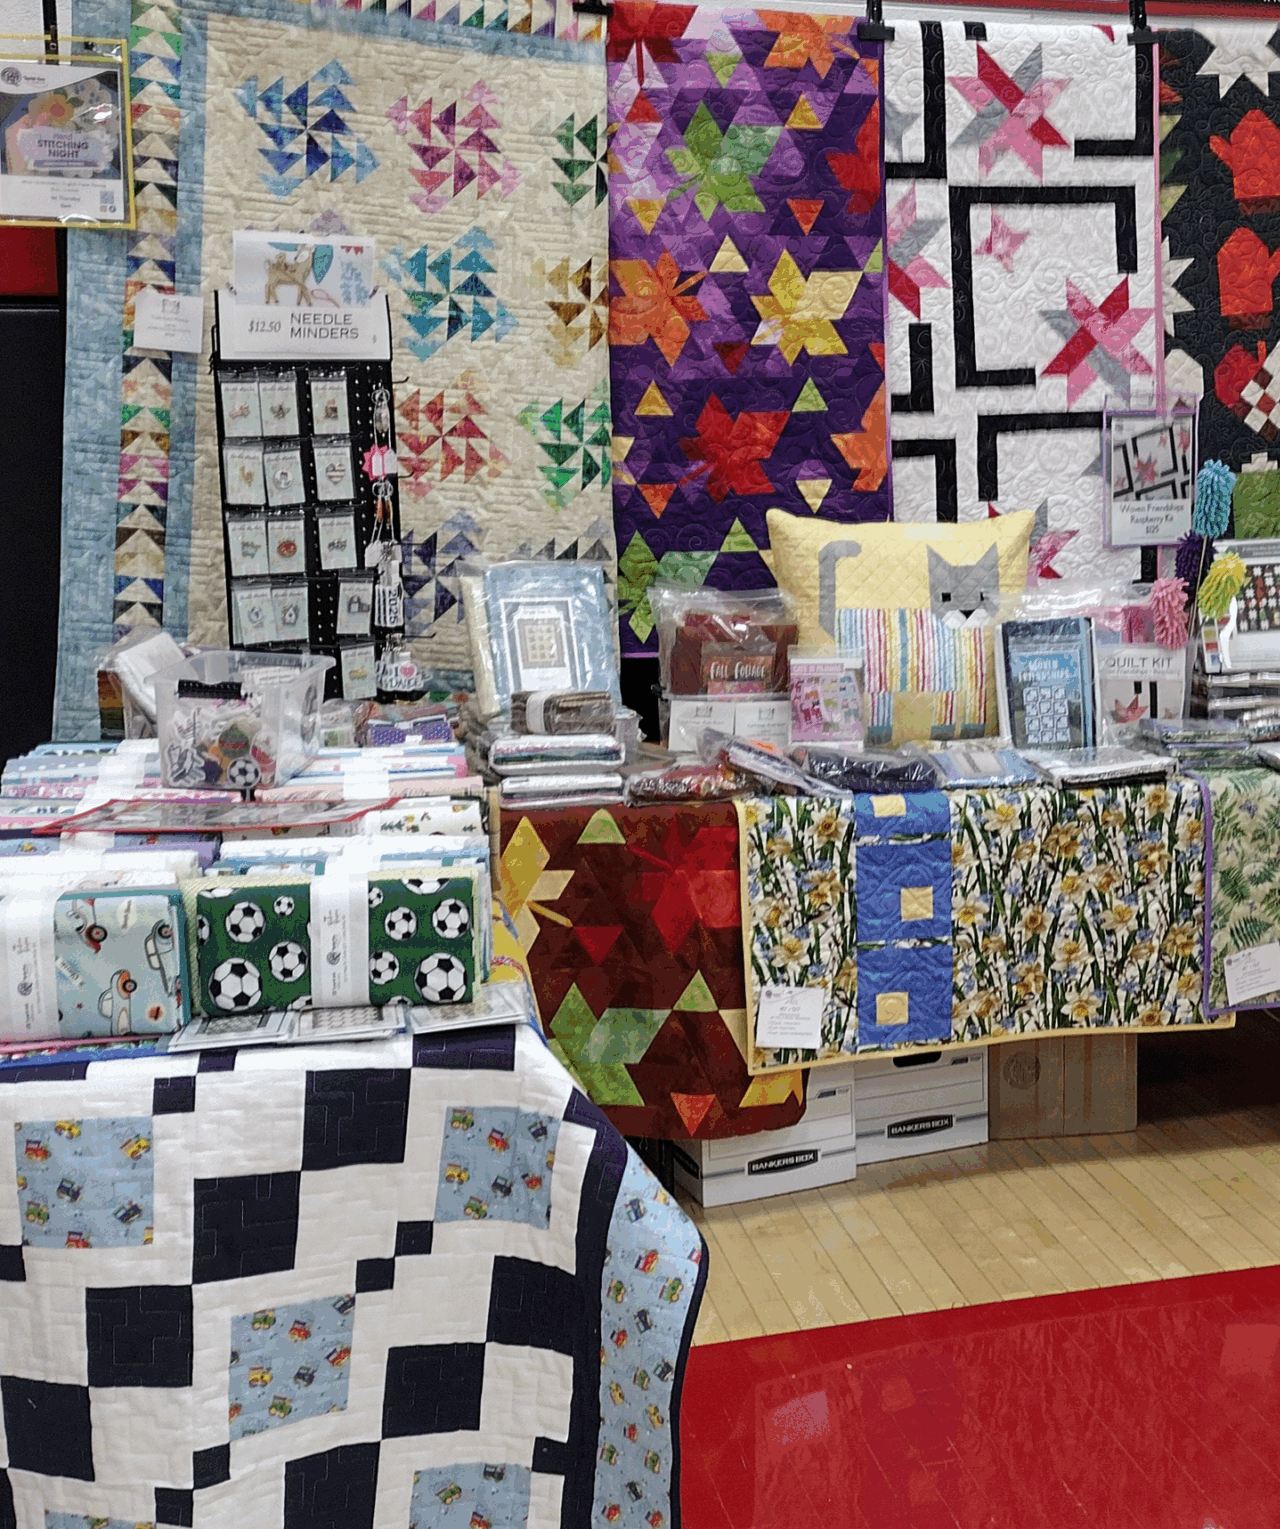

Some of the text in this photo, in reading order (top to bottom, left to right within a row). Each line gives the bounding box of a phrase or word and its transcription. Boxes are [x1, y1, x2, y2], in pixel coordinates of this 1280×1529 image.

[37, 139, 89, 150] STITCHING
[48, 150, 80, 159] NIGHT
[290, 313, 352, 325] NEEDLE
[290, 327, 359, 339] MINDERS
[388, 589, 399, 624] 2025
[1106, 657, 1174, 668] QUILT KIT
[710, 661, 766, 680] FALL FOLIAGE
[891, 1118, 950, 1134] BANKERS BOX
[751, 1152, 814, 1172] BANKERS BOX
